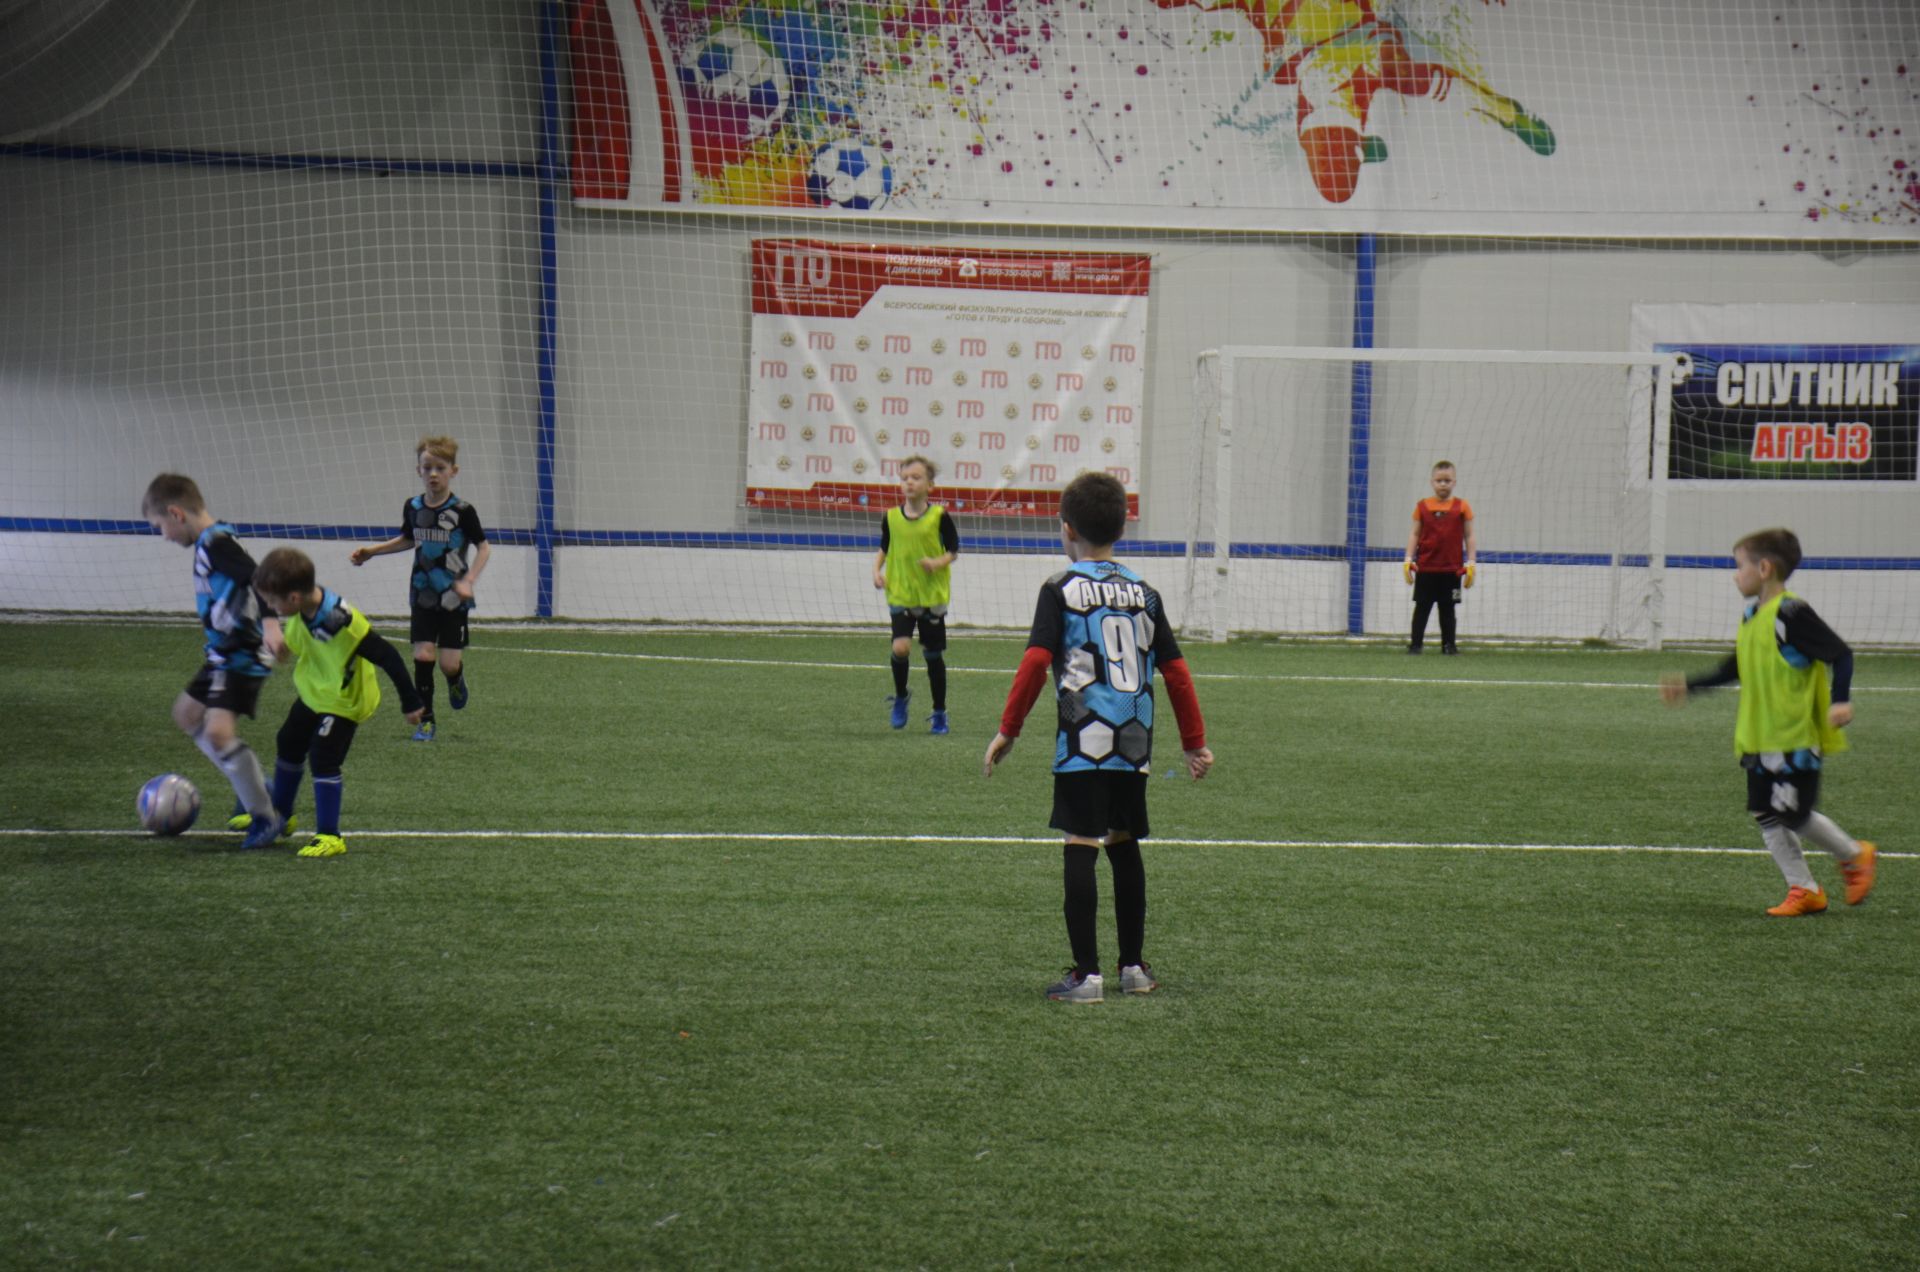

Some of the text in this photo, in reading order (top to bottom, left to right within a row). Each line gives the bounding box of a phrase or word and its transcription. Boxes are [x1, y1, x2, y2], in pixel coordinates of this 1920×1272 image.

[885, 254, 951, 266] ПОДТЯНИСЬ
[776, 248, 831, 297] ГТО
[891, 266, 943, 275] ДВИЖЕНИЮ
[883, 301, 957, 311] ВСЕРОССИЙСКИЙ
[1084, 310, 1128, 318] КОМПЛЕКС
[987, 315, 1012, 323] ТРУДУ
[808, 331, 835, 350] ГТО
[883, 335, 911, 353] ГТО
[960, 338, 986, 357] ГТО
[1035, 341, 1062, 360] ГТО
[1109, 343, 1136, 362] ГТО
[760, 360, 787, 378] ГТО
[830, 363, 857, 382] ГТО
[906, 367, 933, 385] ГТО
[981, 370, 1008, 389] ГТО
[1056, 373, 1083, 391] ГТО
[1716, 361, 1901, 407] СПУТНИК
[807, 393, 834, 412] ГТО
[882, 396, 909, 415] ГТО
[957, 400, 984, 418] ГТО
[1032, 403, 1059, 421] ГТО
[1106, 405, 1133, 424] ГТО
[759, 422, 786, 441] ГТО
[829, 425, 855, 444] ГТО
[903, 428, 930, 447] ГТО
[979, 432, 1006, 450] ГТО
[1054, 434, 1080, 452] ГТО
[1752, 422, 1872, 463] АГРЫЗ
[806, 455, 832, 473] ГТО
[955, 461, 981, 480] ГТО
[1030, 464, 1056, 482] ГТО
[1080, 581, 1146, 608] АГРЫЗ
[1101, 614, 1140, 692] 9
[319, 716, 335, 736] 3
